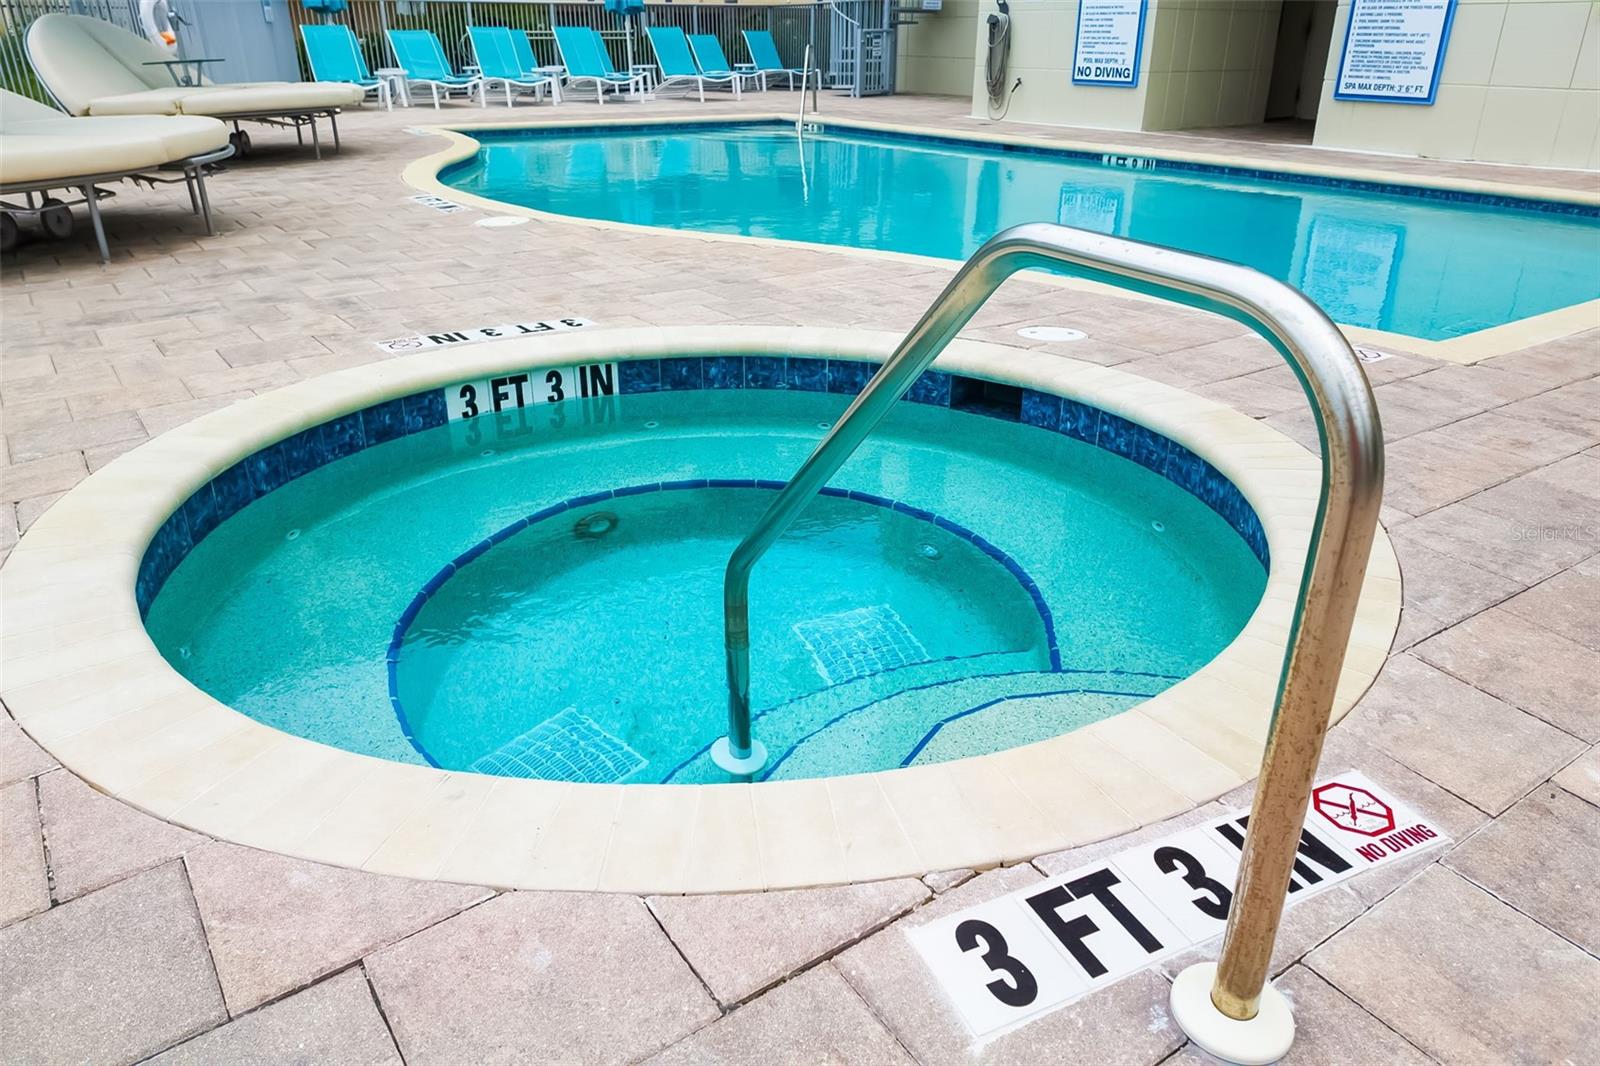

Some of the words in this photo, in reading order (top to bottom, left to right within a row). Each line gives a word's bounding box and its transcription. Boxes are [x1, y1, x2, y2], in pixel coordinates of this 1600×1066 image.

[1077, 66, 1092, 77] NO
[1094, 66, 1130, 78] DIVING
[1344, 82, 1356, 90] SPA
[516, 322, 556, 334] FT
[427, 332, 470, 345] IN
[460, 384, 478, 418] 3
[491, 374, 528, 412] FT
[546, 370, 564, 402] 3
[578, 364, 614, 398] IN
[1355, 842, 1387, 862] NO
[1379, 824, 1438, 853] DIVING
[955, 919, 1038, 1008] 3
[1024, 867, 1165, 979] FT
[1153, 846, 1233, 921] 3
